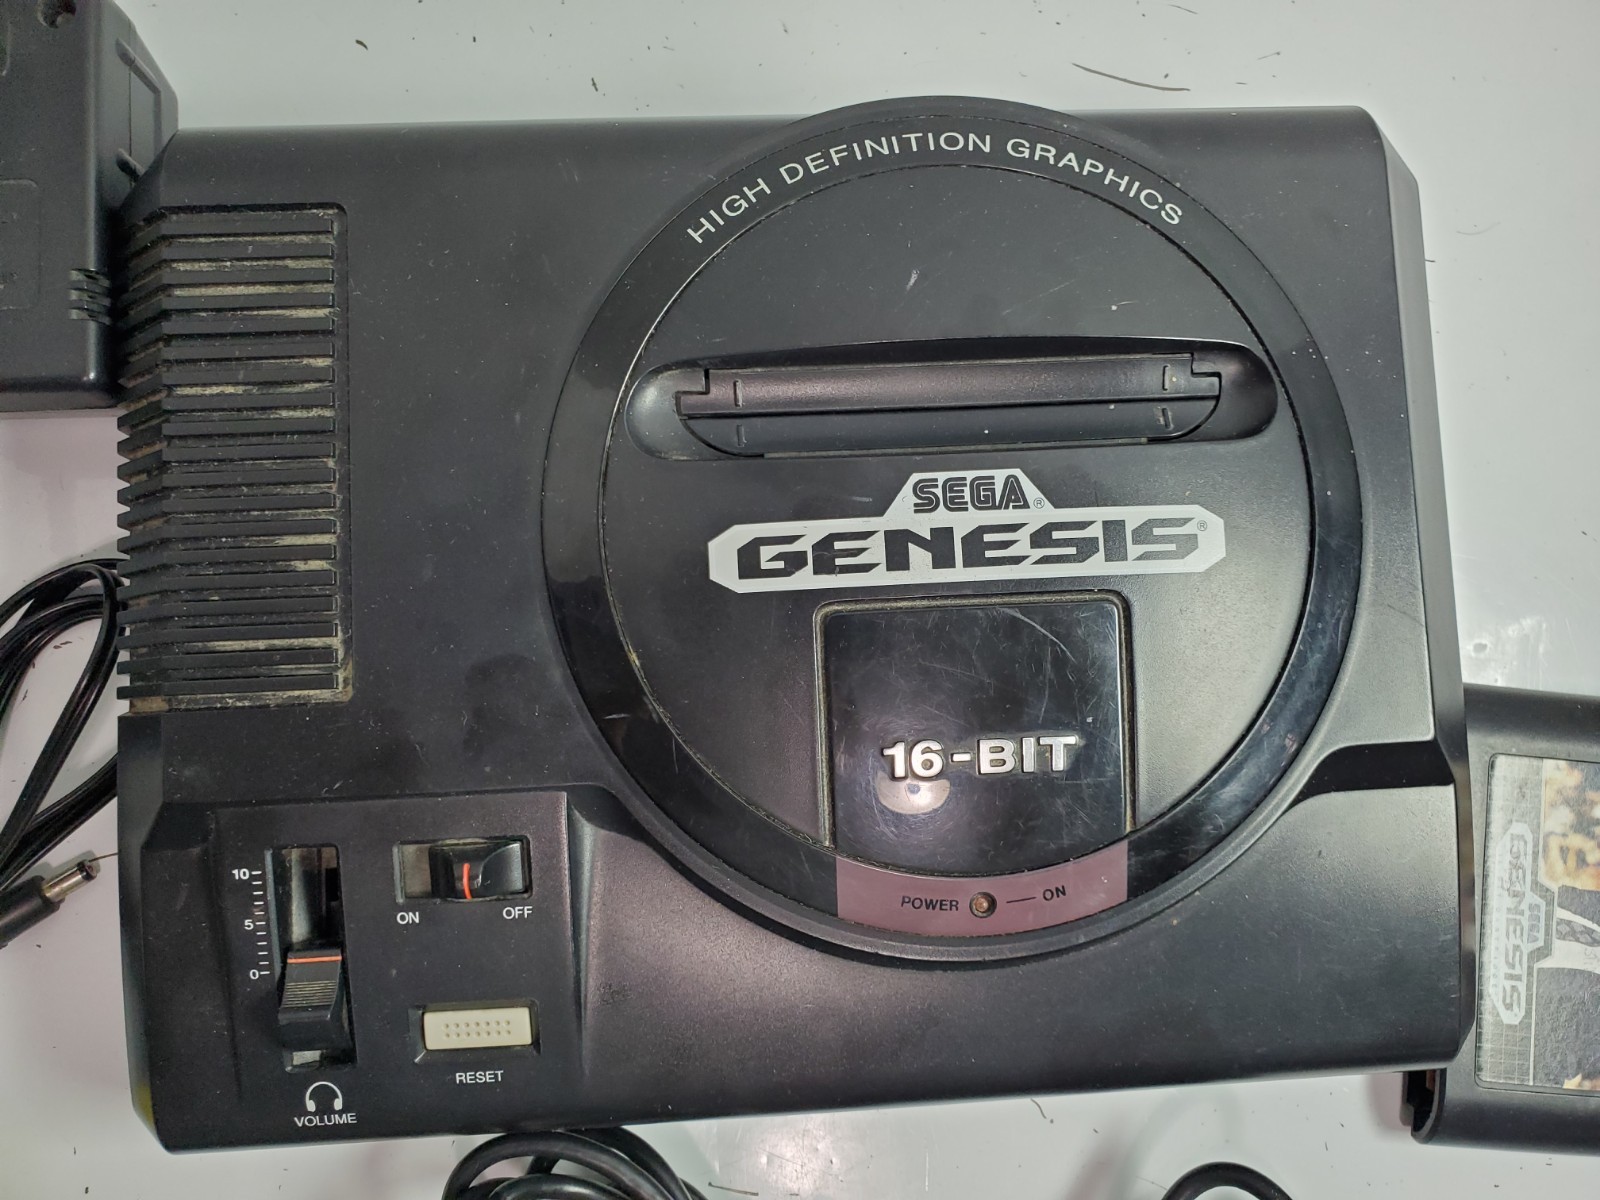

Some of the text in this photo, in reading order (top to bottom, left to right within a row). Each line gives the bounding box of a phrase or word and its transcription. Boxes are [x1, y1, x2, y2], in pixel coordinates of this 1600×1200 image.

[686, 131, 1184, 244] HIGH DEFINITION GRAPHICS
[882, 735, 1078, 779] 16-BIT
[231, 867, 250, 881] 10
[900, 884, 1067, 912] POWER ON
[396, 911, 421, 925] ON
[502, 906, 533, 920] OFF
[243, 918, 254, 931] 5
[1526, 902, 1542, 944] SEGA
[454, 1069, 505, 1085] RESET
[293, 1112, 358, 1128] VOLUME
